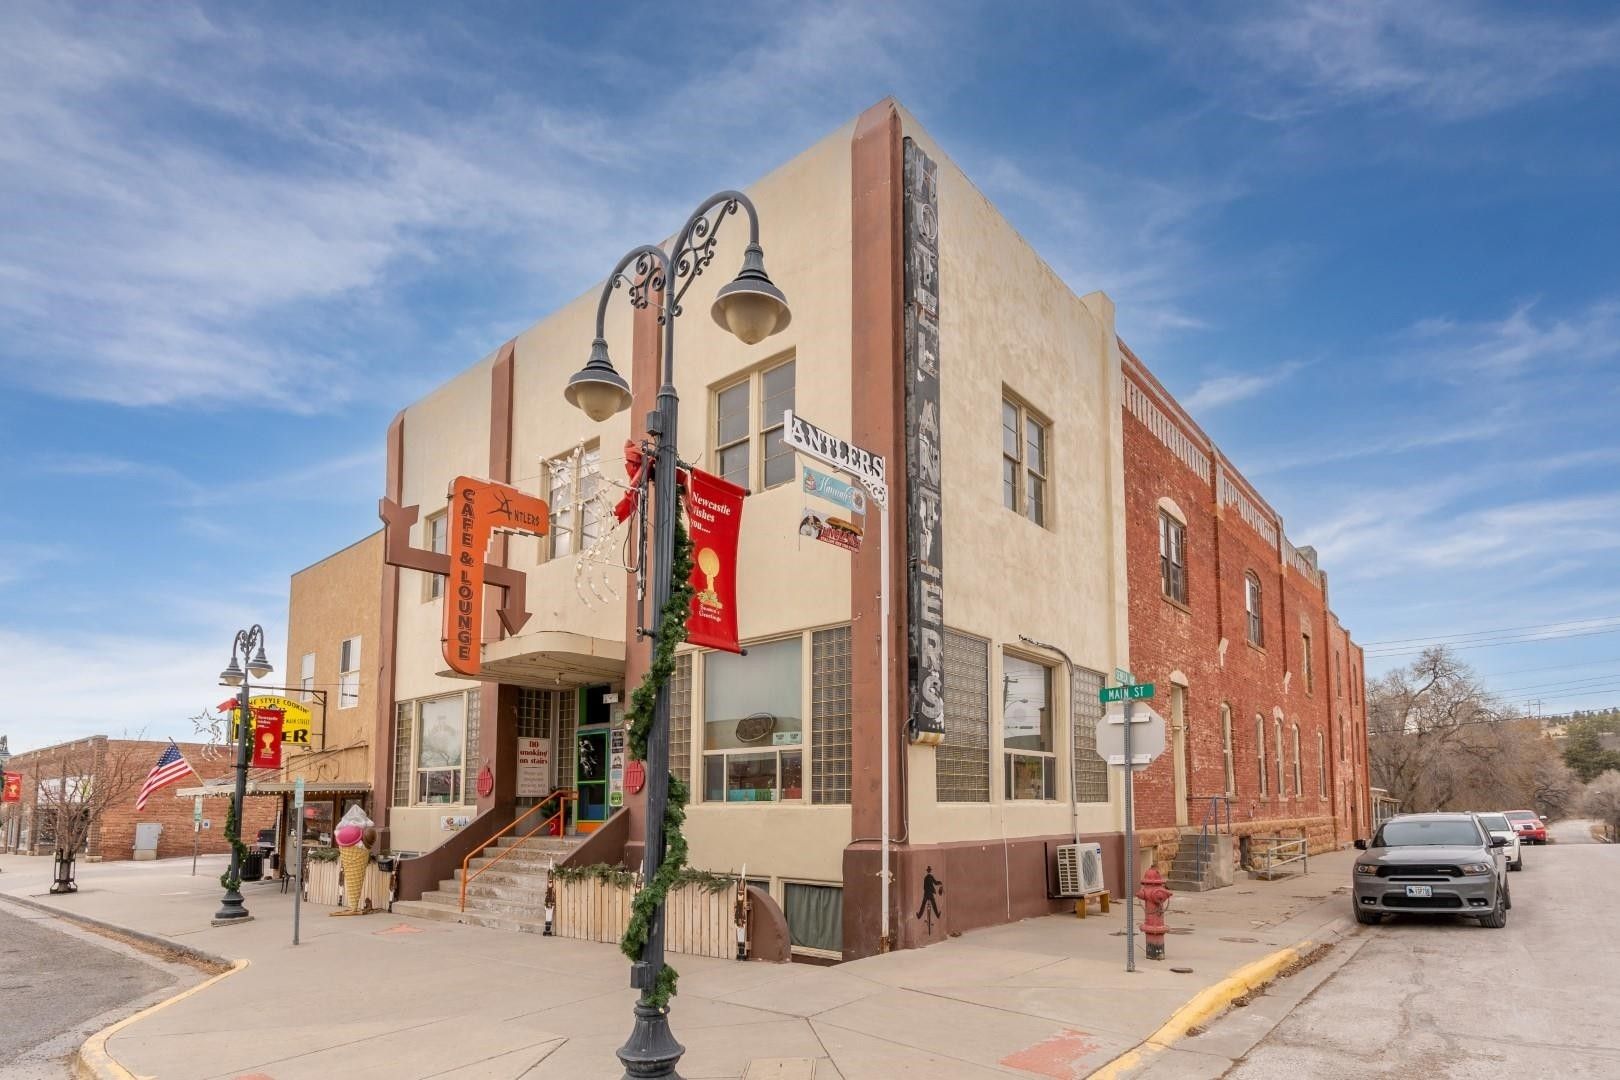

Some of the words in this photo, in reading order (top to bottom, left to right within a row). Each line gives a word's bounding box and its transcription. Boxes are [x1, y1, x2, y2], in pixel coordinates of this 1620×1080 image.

[792, 417, 884, 481] ANTLERS
[492, 494, 541, 526] ANTLERS
[692, 491, 731, 516] Newcastle
[693, 508, 715, 523] ishes
[460, 488, 476, 548] CAFE
[459, 551, 474, 567] &
[918, 399, 944, 721] ANTLERS
[458, 570, 475, 661] LOUNGE
[1109, 688, 1129, 700] MAIN
[1135, 687, 1144, 697] ST
[519, 749, 548, 758] smoking
